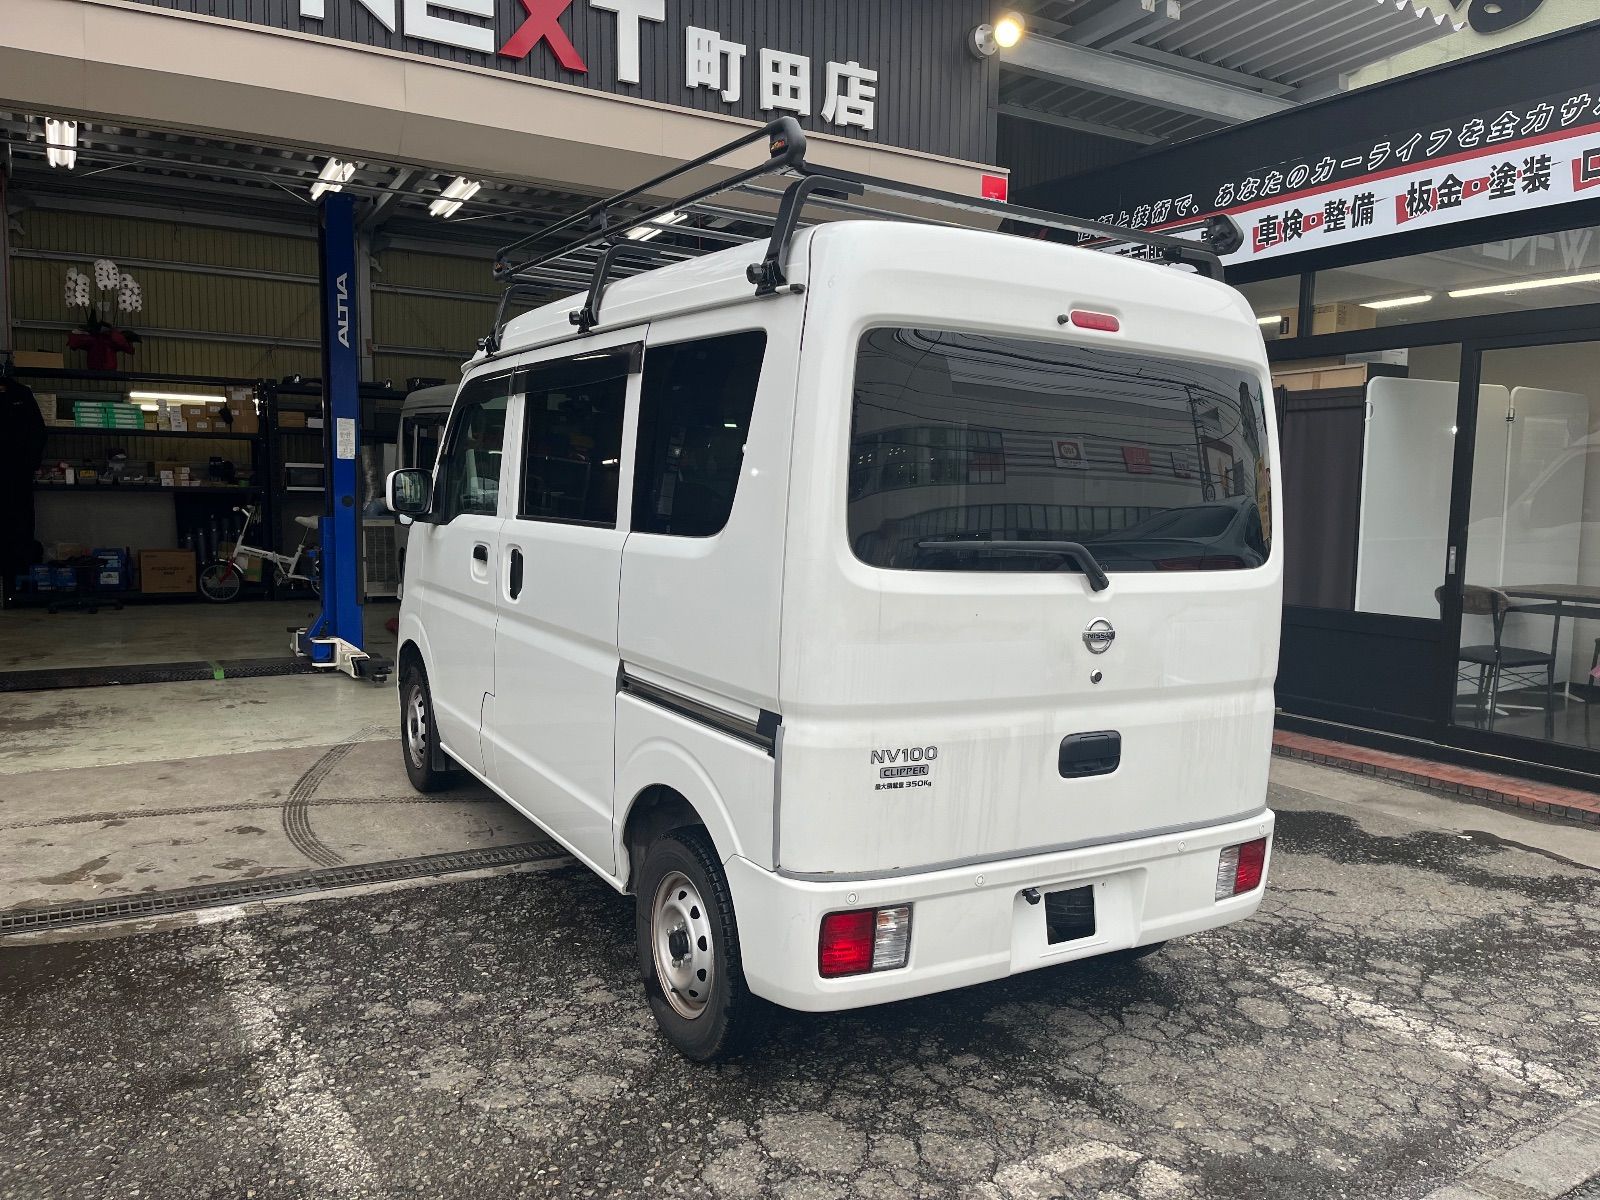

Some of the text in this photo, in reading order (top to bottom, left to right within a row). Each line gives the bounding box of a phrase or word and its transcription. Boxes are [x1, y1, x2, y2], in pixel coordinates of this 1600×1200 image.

[300, 0, 877, 130] EXT 町田店
[1257, 192, 1375, 246] 車検・整備
[1406, 154, 1552, 216] 板金・塗装
[337, 272, 350, 349] ALTIA
[870, 746, 938, 764] NV100
[883, 766, 926, 777] CLIPPER
